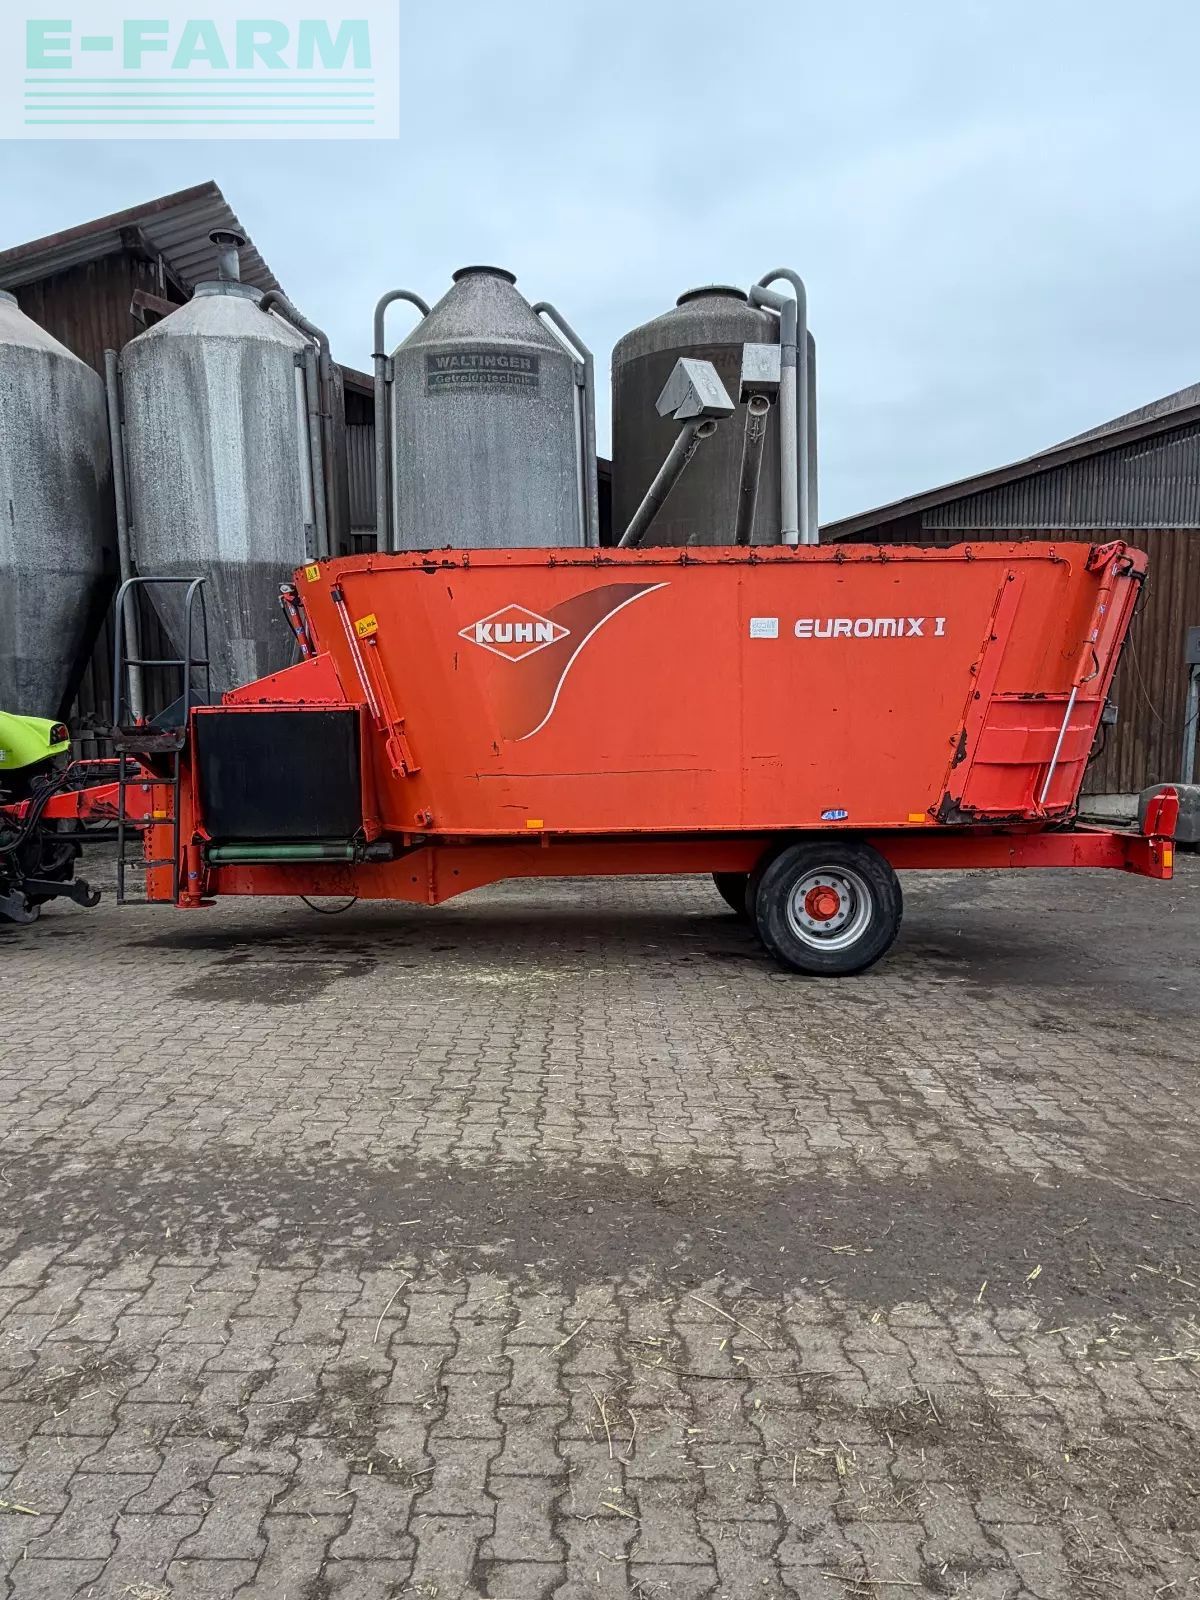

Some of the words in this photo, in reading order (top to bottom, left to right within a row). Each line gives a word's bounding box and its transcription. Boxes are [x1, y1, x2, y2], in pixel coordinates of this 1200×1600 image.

[435, 355, 532, 370] WALTINGER
[476, 622, 554, 643] KUHN
[794, 617, 926, 638] EUROMIX
